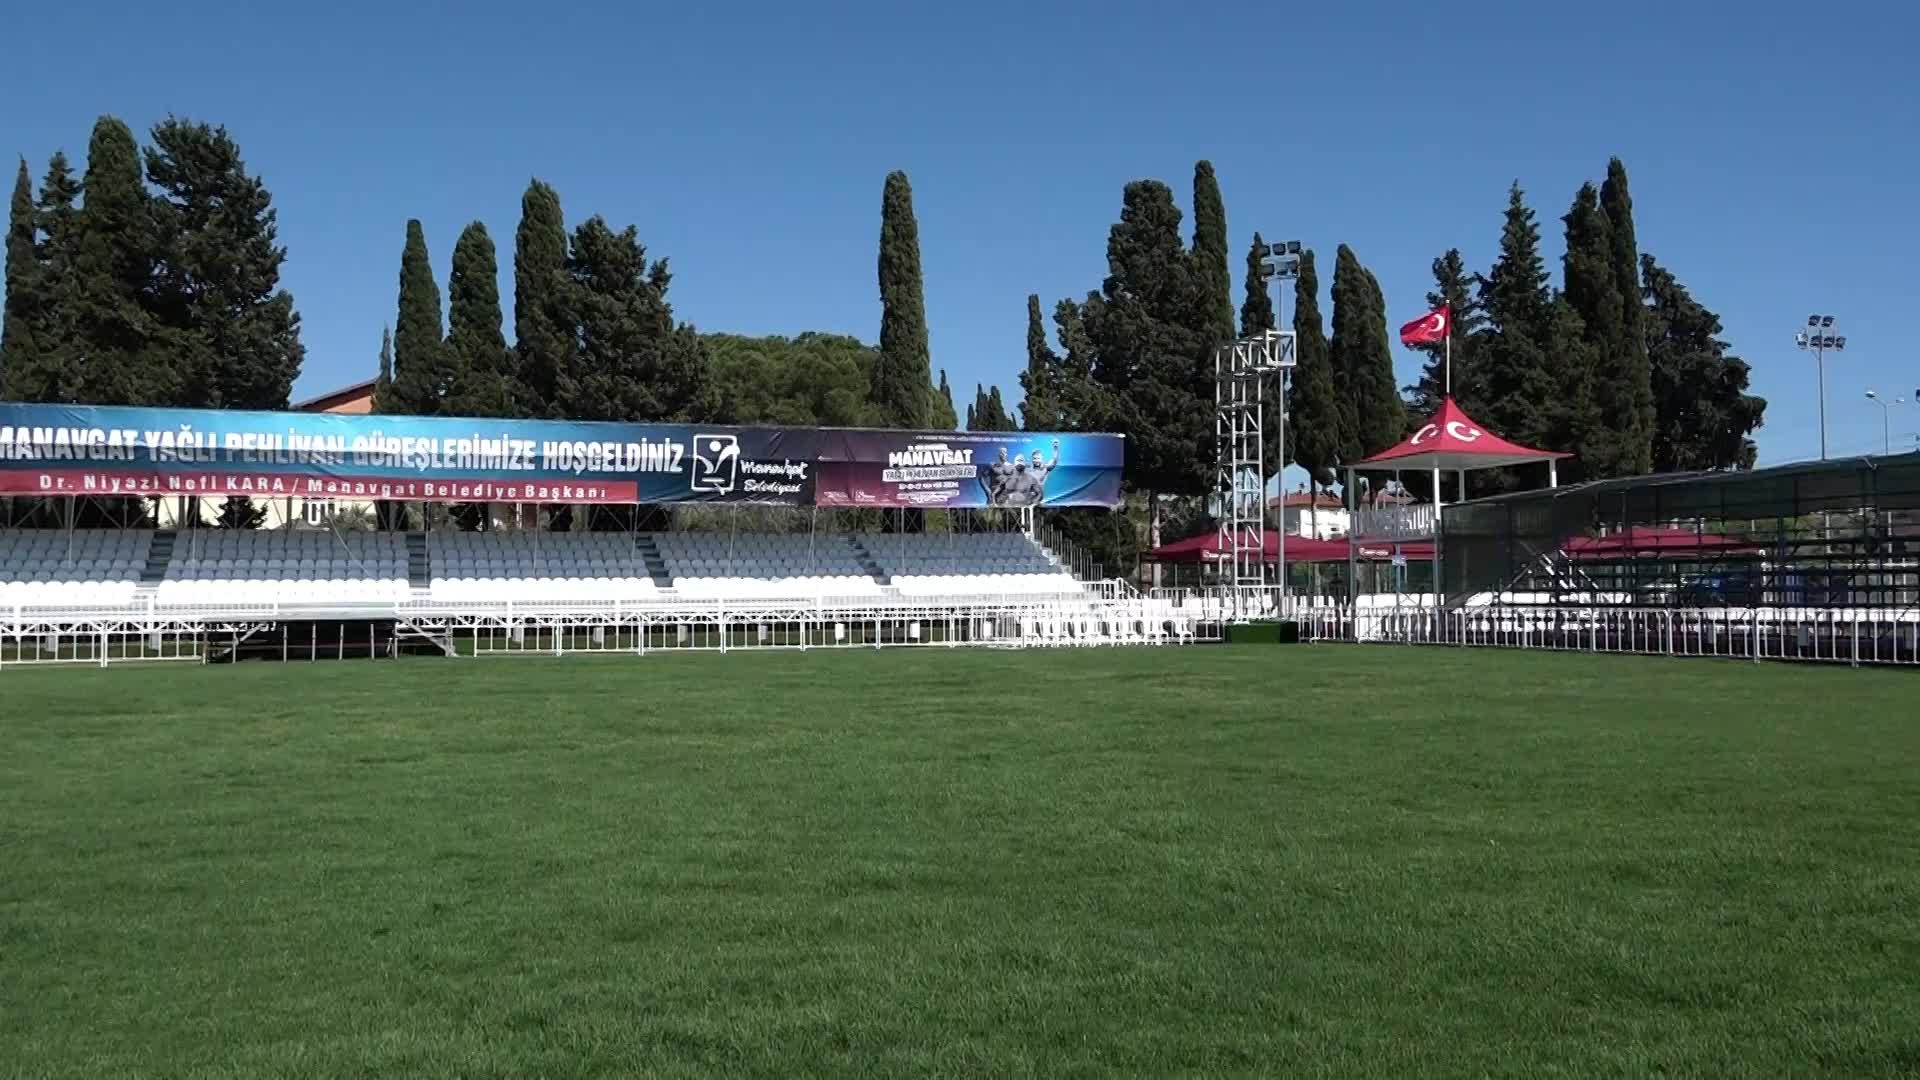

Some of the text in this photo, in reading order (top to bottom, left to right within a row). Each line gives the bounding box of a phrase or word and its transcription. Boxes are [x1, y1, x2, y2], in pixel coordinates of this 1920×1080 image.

[0, 424, 685, 476] MANAVGAT YAĞLI PEHLİVAN GÜREŞLERİMİZE HOŞGELDİNİZ
[889, 449, 974, 468] MANAVGAT
[39, 475, 74, 490] Dr.
[84, 475, 159, 494] Niyazi
[169, 475, 217, 490] Nefi
[227, 477, 285, 492] KARA
[308, 479, 416, 498] Manavgat
[424, 482, 517, 500] Belediye
[525, 484, 606, 502] Başkanı
